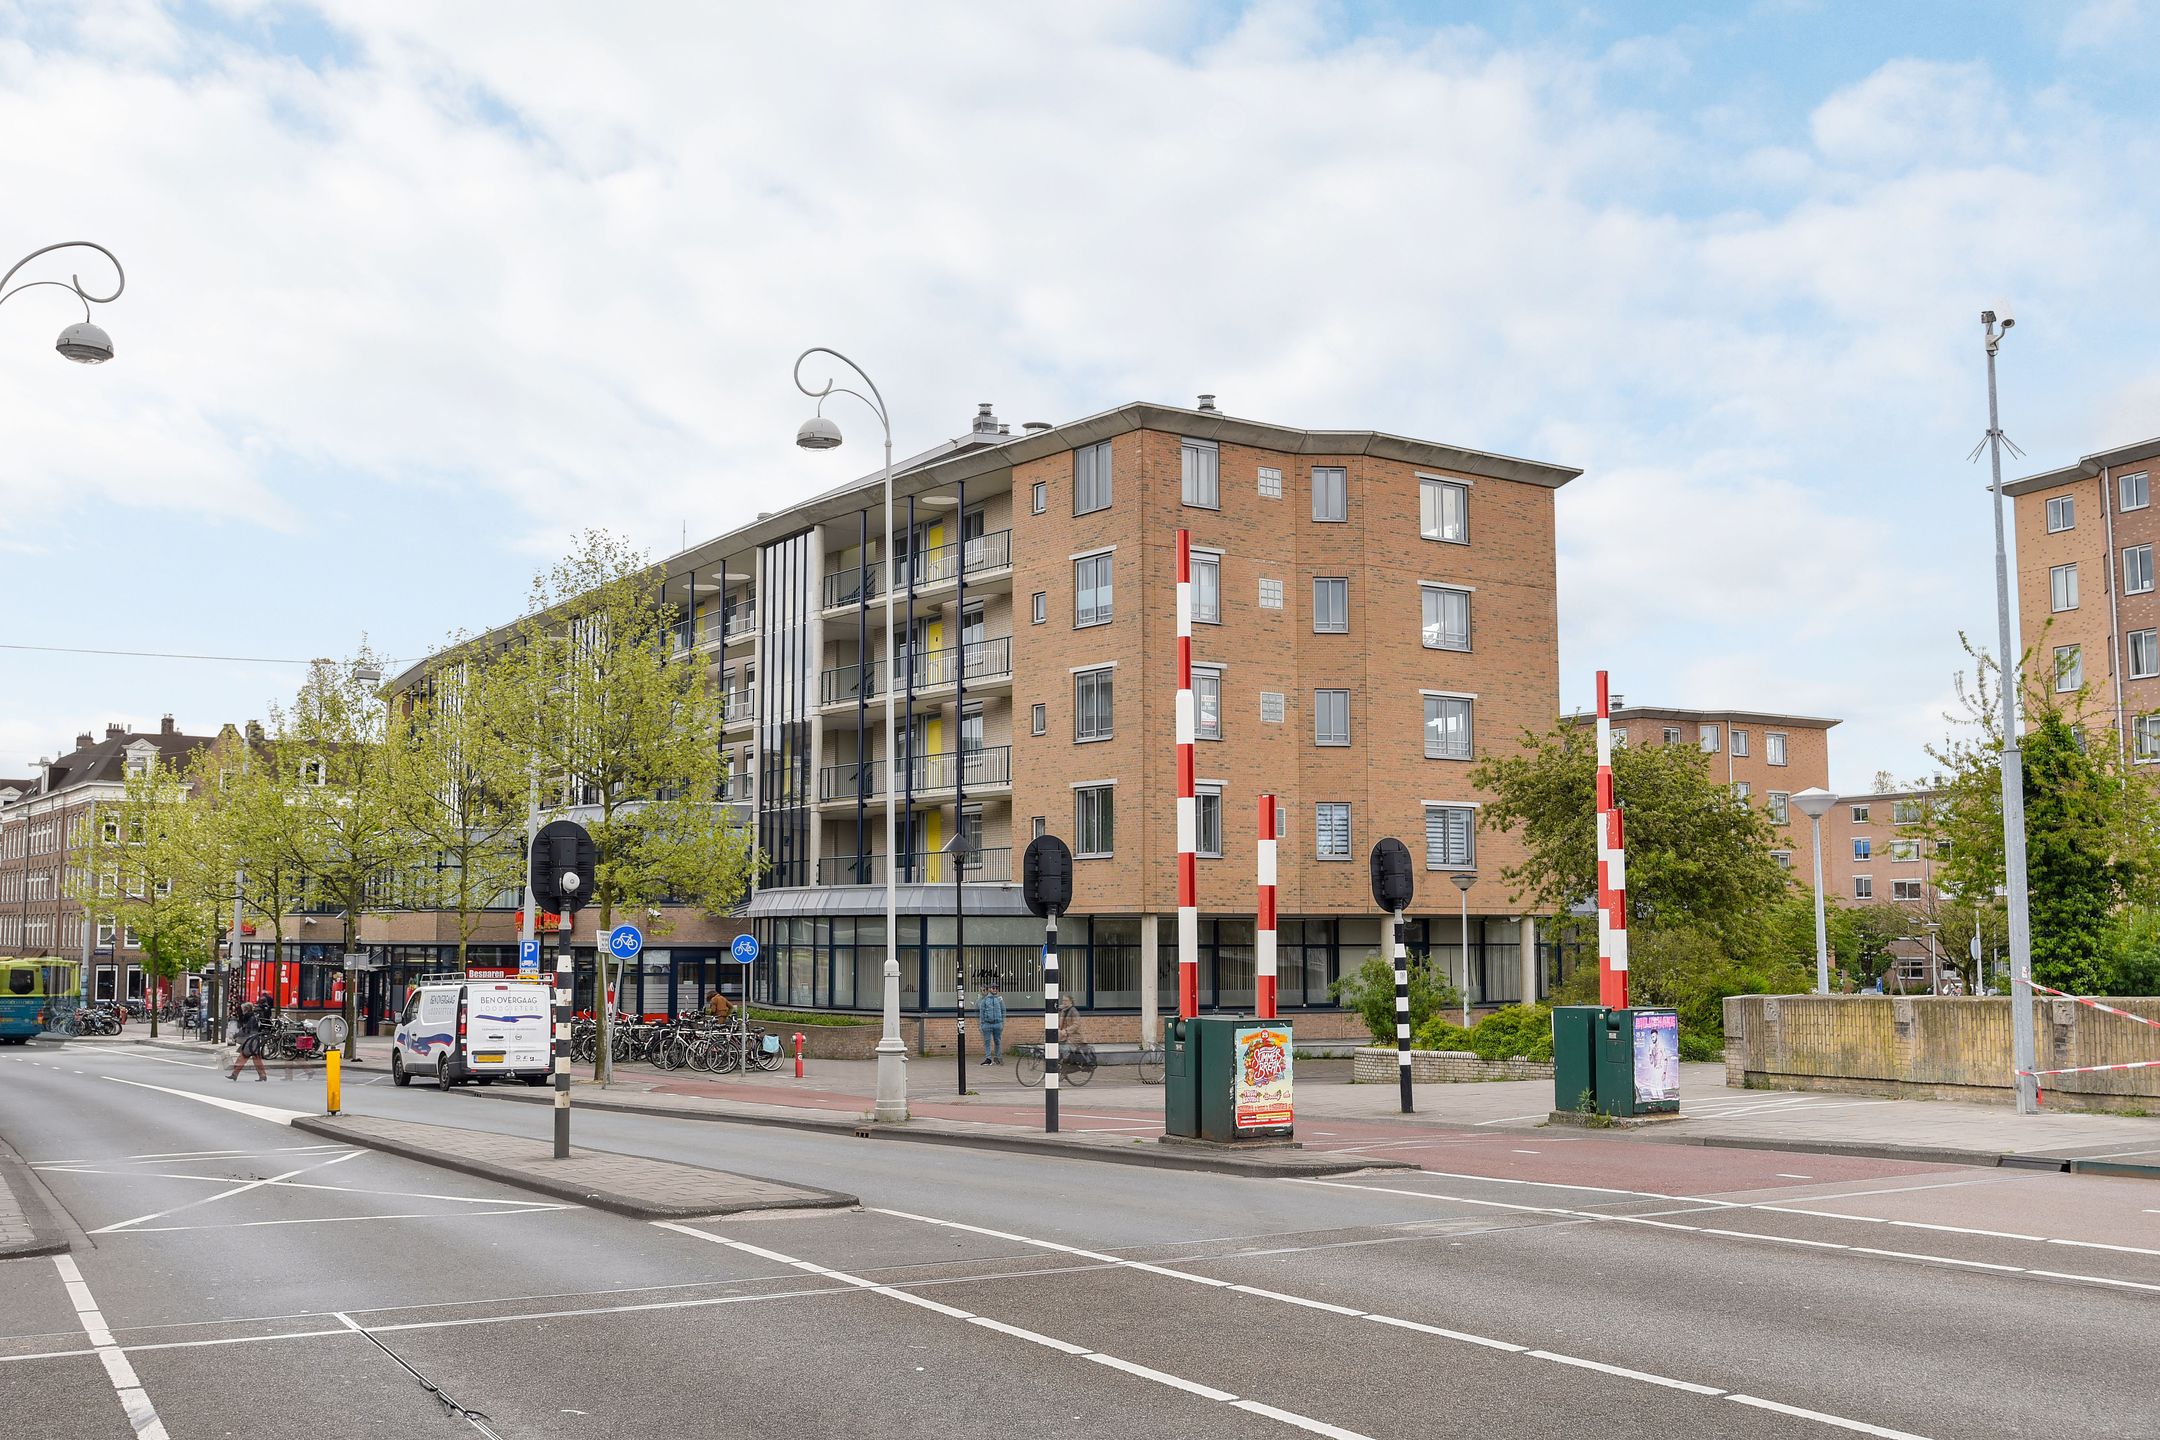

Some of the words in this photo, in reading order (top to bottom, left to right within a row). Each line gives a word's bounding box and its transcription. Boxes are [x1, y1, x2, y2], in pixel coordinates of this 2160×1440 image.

[524, 942, 535, 957] P
[480, 996, 496, 1004] BEN
[496, 996, 538, 1004] OVERGAAG
